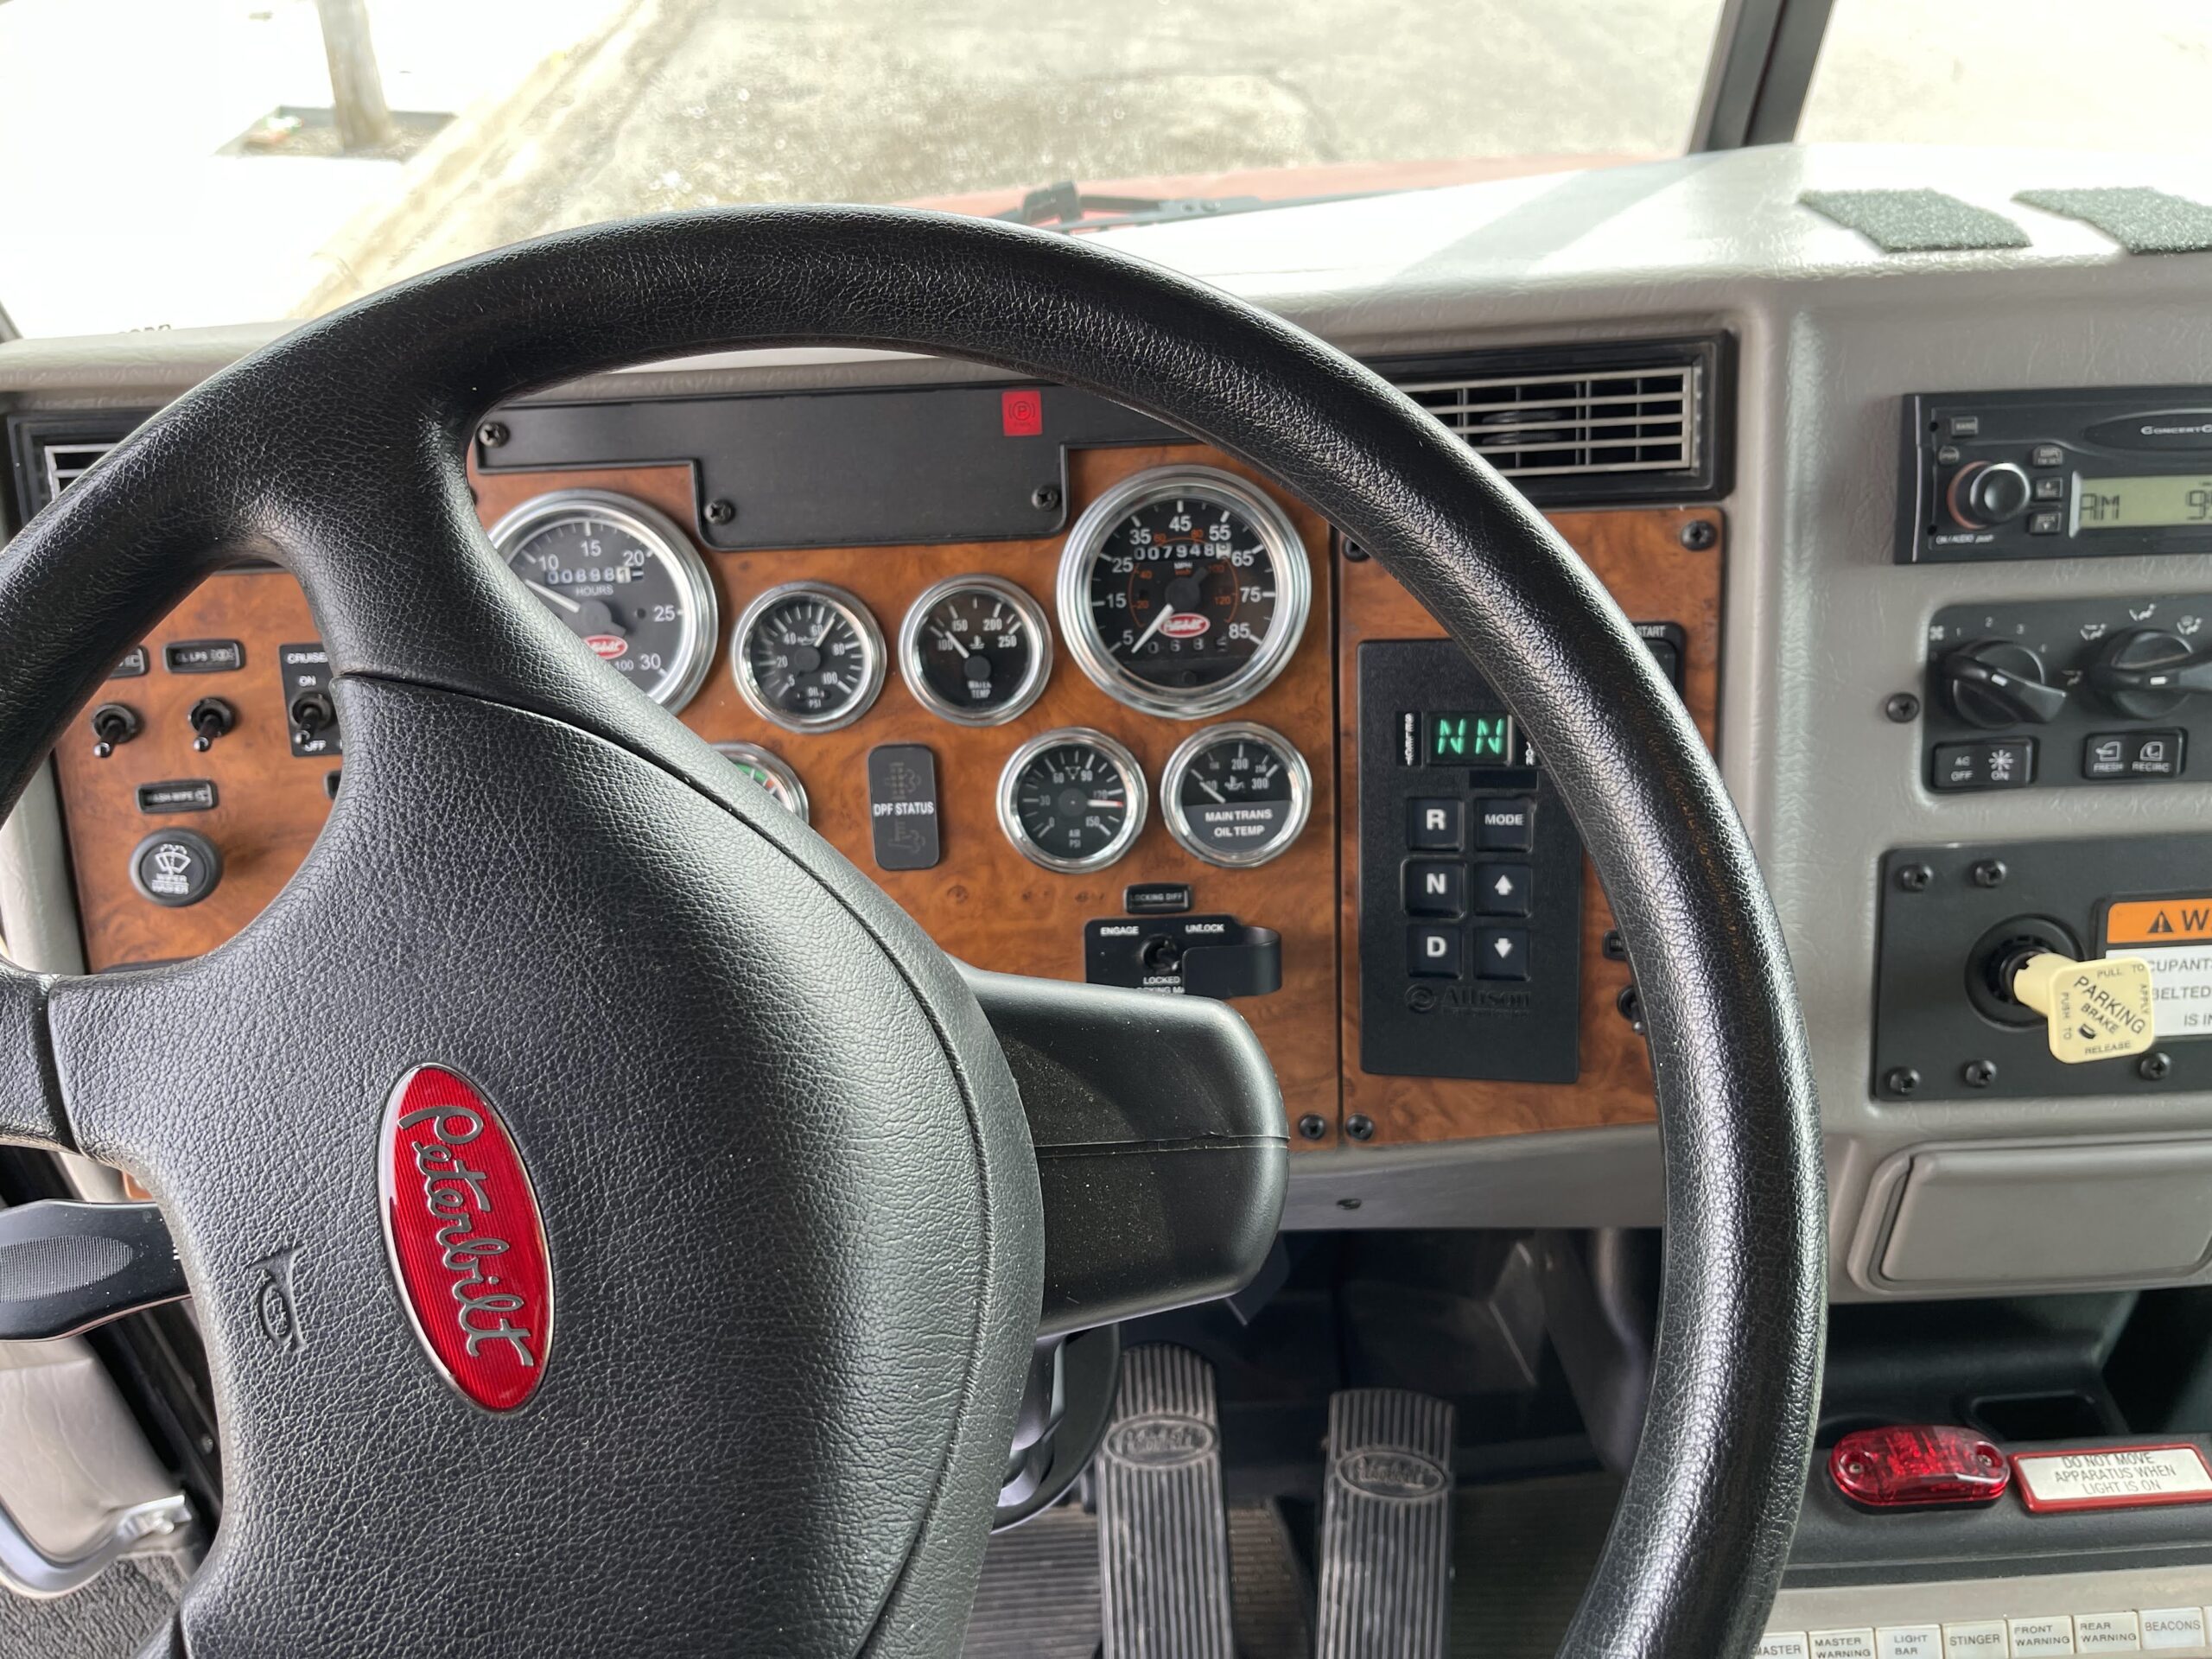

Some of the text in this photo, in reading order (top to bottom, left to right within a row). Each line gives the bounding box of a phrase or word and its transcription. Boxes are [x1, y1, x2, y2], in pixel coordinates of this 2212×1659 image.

[2081, 493, 2120, 520] AM
[1168, 516, 1192, 531] 45
[1129, 529, 1152, 545] 35
[1209, 524, 1231, 541] 55
[581, 540, 602, 557] 15
[539, 554, 559, 570] 10
[622, 550, 645, 567] 20
[1231, 550, 1255, 567] 65
[1112, 557, 1134, 574] 25
[1139, 570, 1153, 579] 40
[575, 585, 613, 596] HOURS
[1240, 587, 1262, 603] 75
[1106, 594, 1127, 608] 15
[1136, 600, 1149, 608] 20
[1214, 596, 1231, 605] 120
[654, 606, 676, 622] 25
[952, 619, 969, 632] 150
[982, 619, 1002, 632] 200
[1985, 617, 1993, 627] 2
[810, 625, 823, 637] 60
[1229, 623, 1251, 639] 85
[2017, 624, 2024, 634] 3
[784, 634, 797, 645] 40
[997, 636, 1018, 648] 250
[1122, 630, 1134, 645] 5
[832, 644, 845, 656] 80
[287, 652, 327, 664] CRUISE
[639, 653, 661, 671] 30
[777, 656, 788, 668] 20
[614, 659, 634, 671] 100
[298, 676, 316, 686] ON
[788, 674, 796, 687] 5
[823, 672, 838, 684] 100
[808, 687, 820, 697] OIL
[970, 690, 991, 698] TEMP
[809, 699, 822, 709] PSI
[1231, 758, 1250, 770] 200
[1052, 772, 1065, 784] 60
[1080, 770, 1093, 782] 90
[1950, 771, 1974, 781] OFF
[1991, 771, 2009, 781] ON
[1251, 777, 1269, 790] 300
[1039, 795, 1051, 806] 30
[1093, 790, 1108, 799] 120
[874, 801, 934, 817] DPF STATUS
[1085, 816, 1101, 827] 150
[1205, 809, 1273, 822] MAIN TRANS
[1427, 809, 1446, 830] R
[1484, 814, 1524, 826] MODE
[1049, 817, 1055, 828] 0
[1069, 829, 1081, 837] AIR
[1214, 825, 1265, 837] OIL TEMP
[1069, 839, 1081, 849] PSI
[1427, 873, 1446, 894] N
[2182, 909, 2212, 932] W
[1100, 925, 1139, 936] ENGAGE
[1185, 924, 1224, 934] UNLOCK
[1427, 936, 1446, 957] D
[1143, 976, 1181, 985] LOCKED
[2096, 963, 2151, 1014] PULL TO APPLY
[2073, 976, 2146, 1035] PARKING
[2061, 992, 2132, 1055] PUSH TO RELEASE
[2081, 1002, 2120, 1034] BRAKE
[2183, 1014, 2198, 1027] IS
[397, 1105, 534, 1367] Peterbilt
[2062, 1452, 2155, 1469] DO NOT MOVE
[2054, 1465, 2177, 1483] APPARATUS WHEN
[2082, 1479, 2163, 1495] LIGHT IS ON
[2014, 1624, 2054, 1635] FRONT
[2080, 1621, 2111, 1631] REAR
[2145, 1620, 2201, 1632] BEACONS
[1815, 1637, 1862, 1647] MASTER
[1893, 1635, 1928, 1643] LIGHT
[1949, 1634, 2001, 1646] STINGER
[2015, 1636, 2070, 1647] WARNING
[2080, 1633, 2138, 1643] WARNING
[1753, 1644, 1802, 1656] MASTER
[1816, 1649, 1872, 1659] WARNING
[1895, 1647, 1918, 1656] BAR
